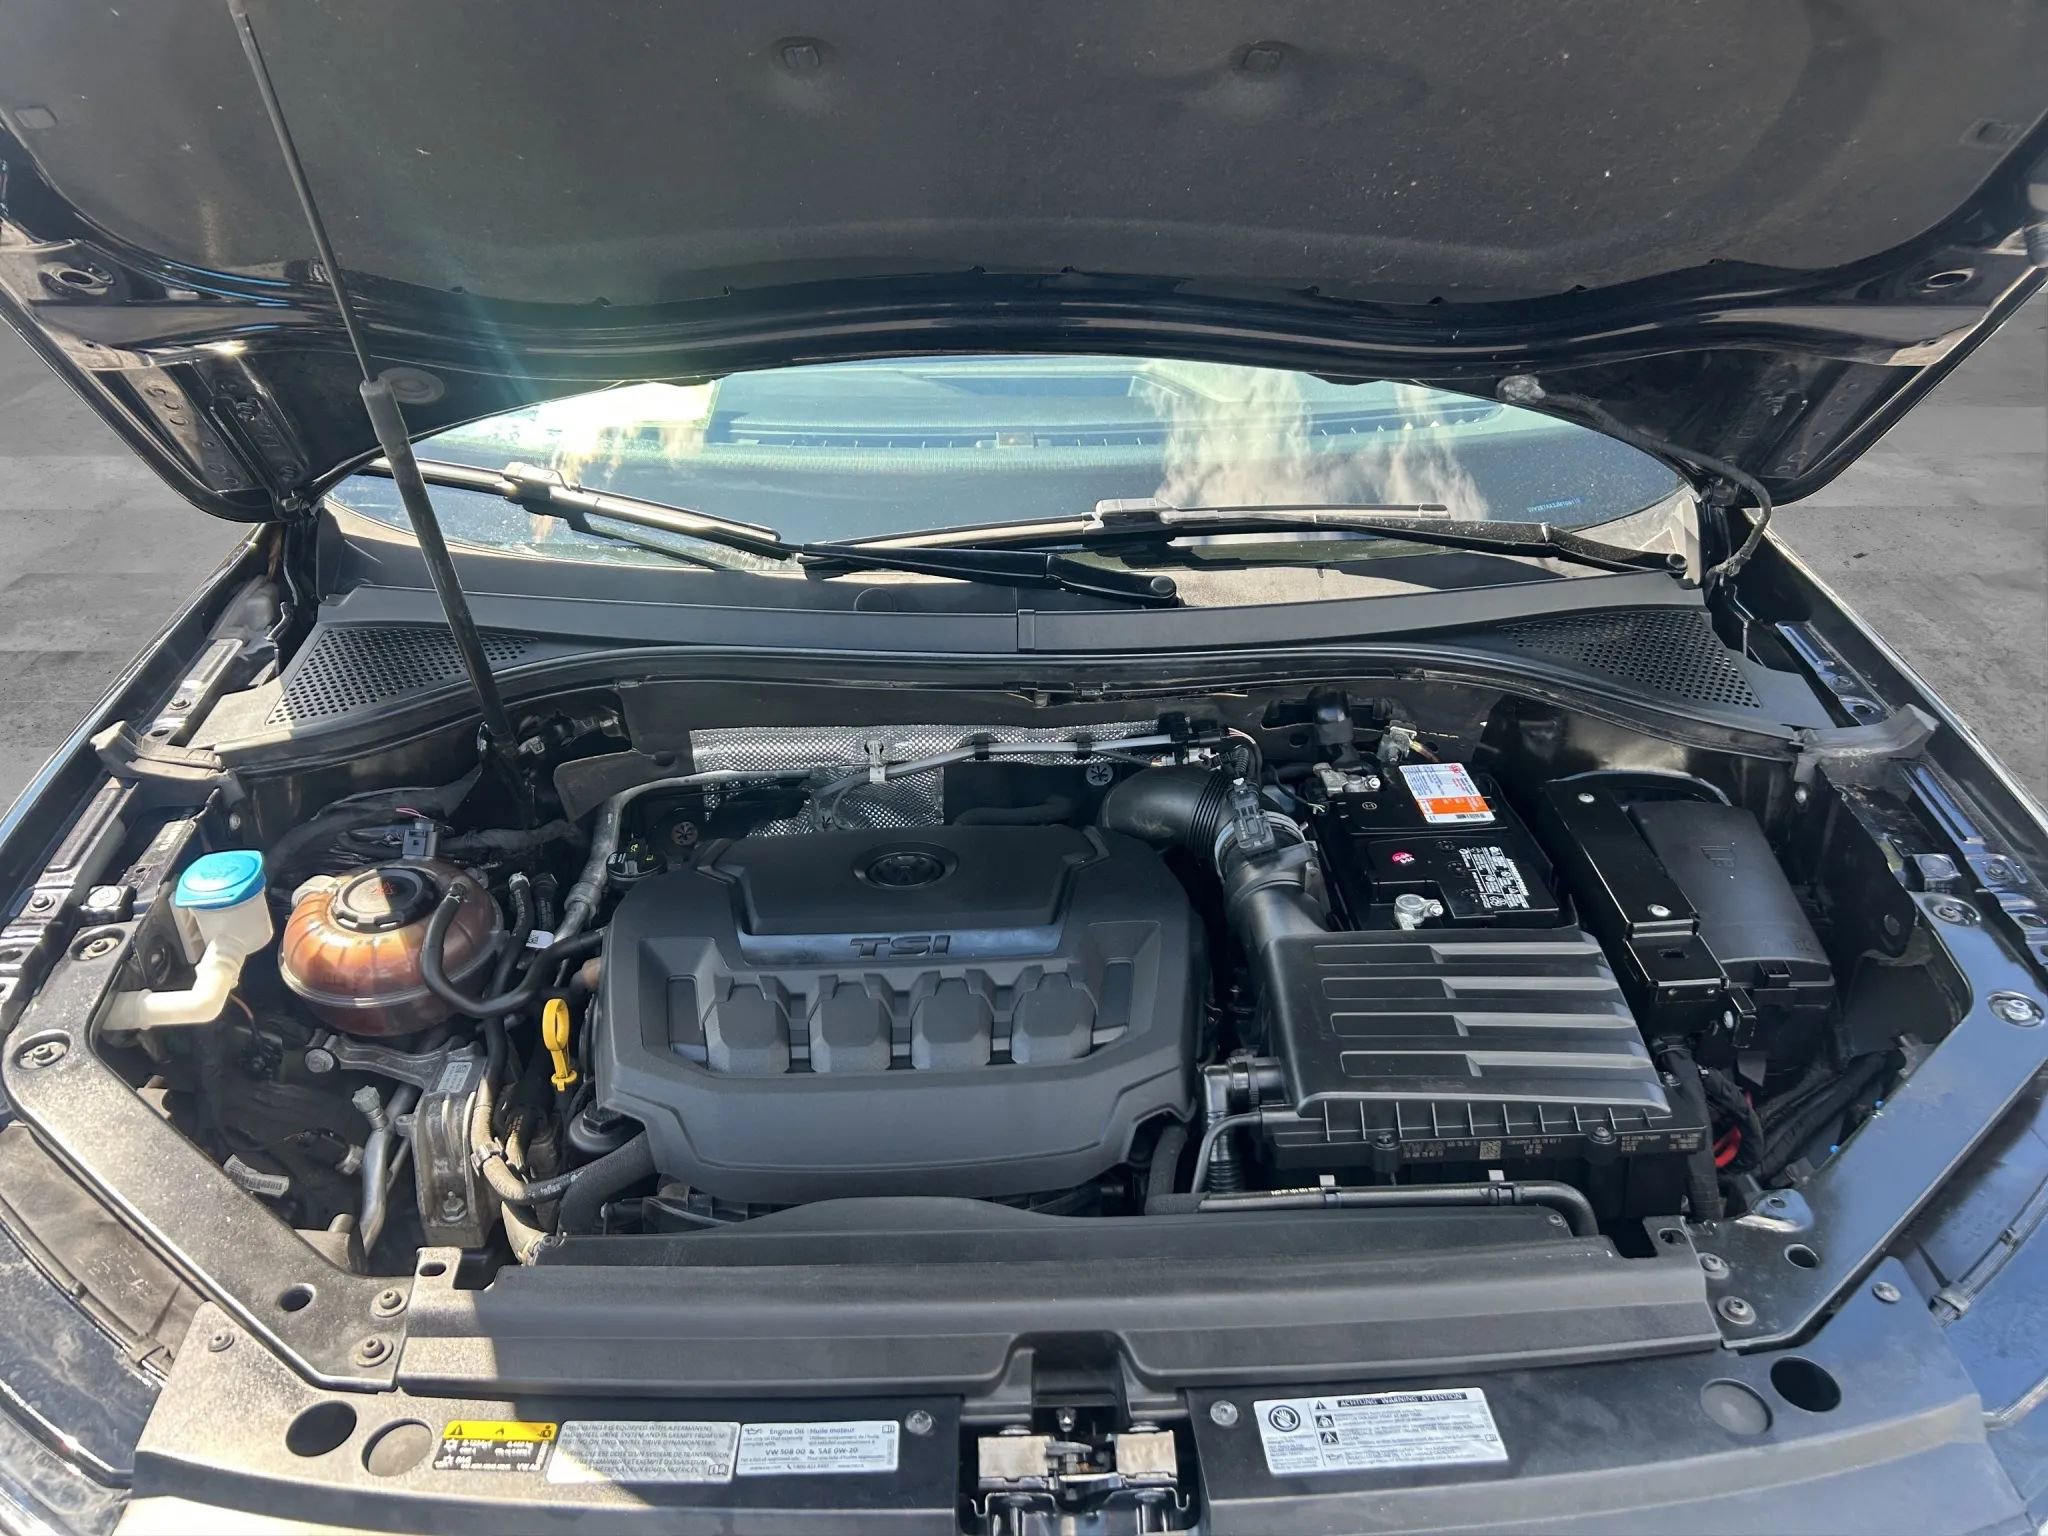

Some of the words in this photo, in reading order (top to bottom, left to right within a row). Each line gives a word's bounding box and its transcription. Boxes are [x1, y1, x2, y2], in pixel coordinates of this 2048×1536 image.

[850, 935, 951, 957] TSI
[1341, 1398, 1378, 1407] ACHTUNG
[1381, 1395, 1418, 1404] WARNING
[1422, 1392, 1463, 1401] ATTENTION
[770, 1428, 792, 1437] Engine
[834, 1446, 858, 1454] 0W-20
